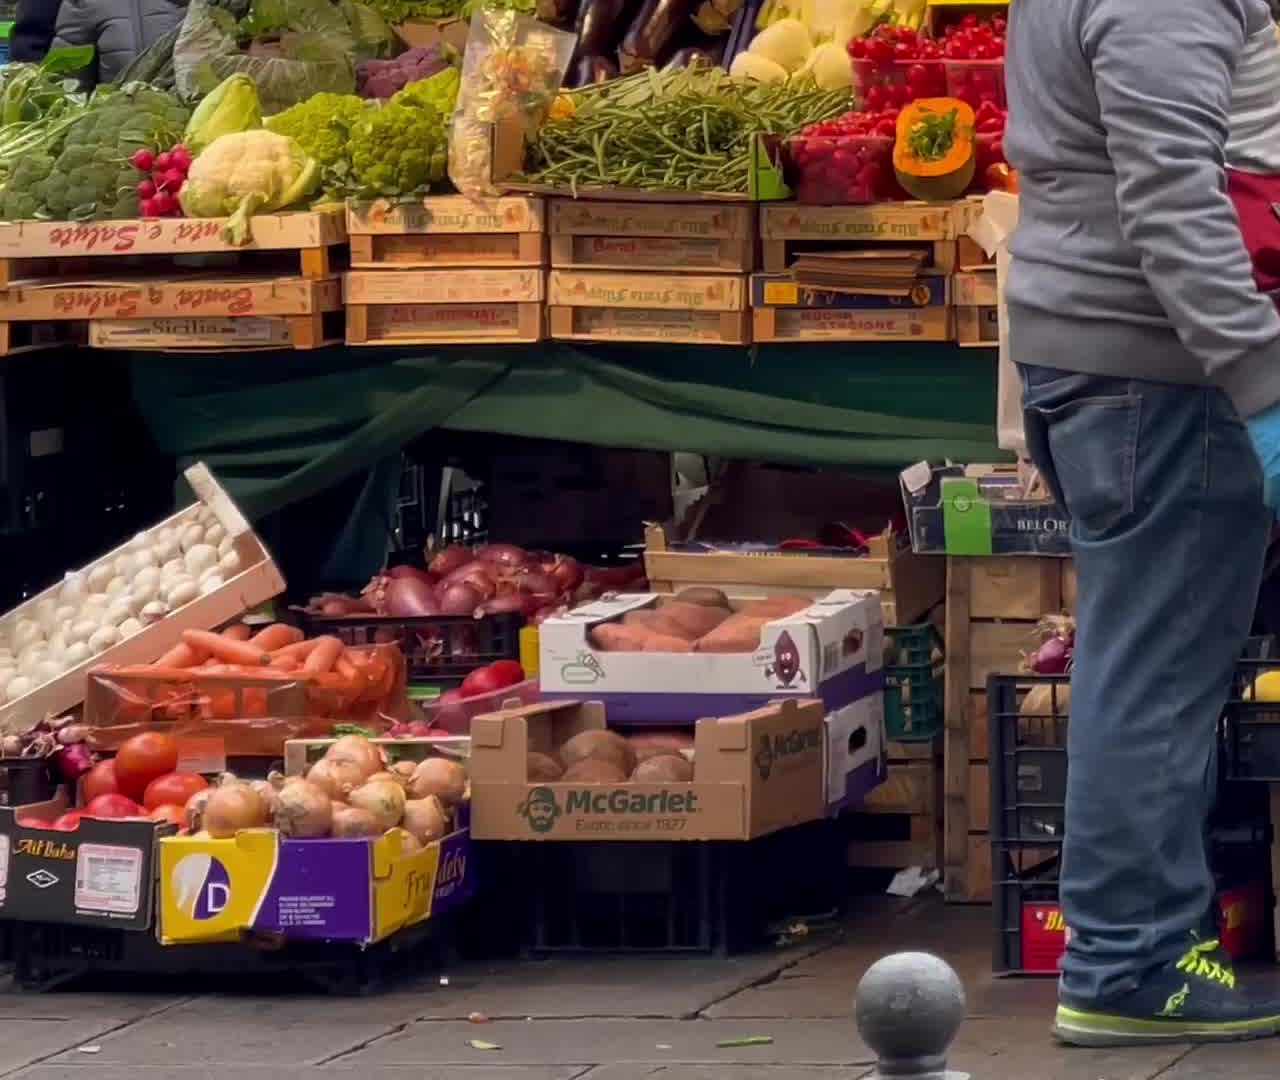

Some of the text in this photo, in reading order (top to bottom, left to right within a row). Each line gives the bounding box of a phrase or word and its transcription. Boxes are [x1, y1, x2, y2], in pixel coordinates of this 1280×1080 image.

[48, 224, 140, 252] Salute
[171, 222, 219, 246] nta'
[566, 790, 699, 814] McGarlet
